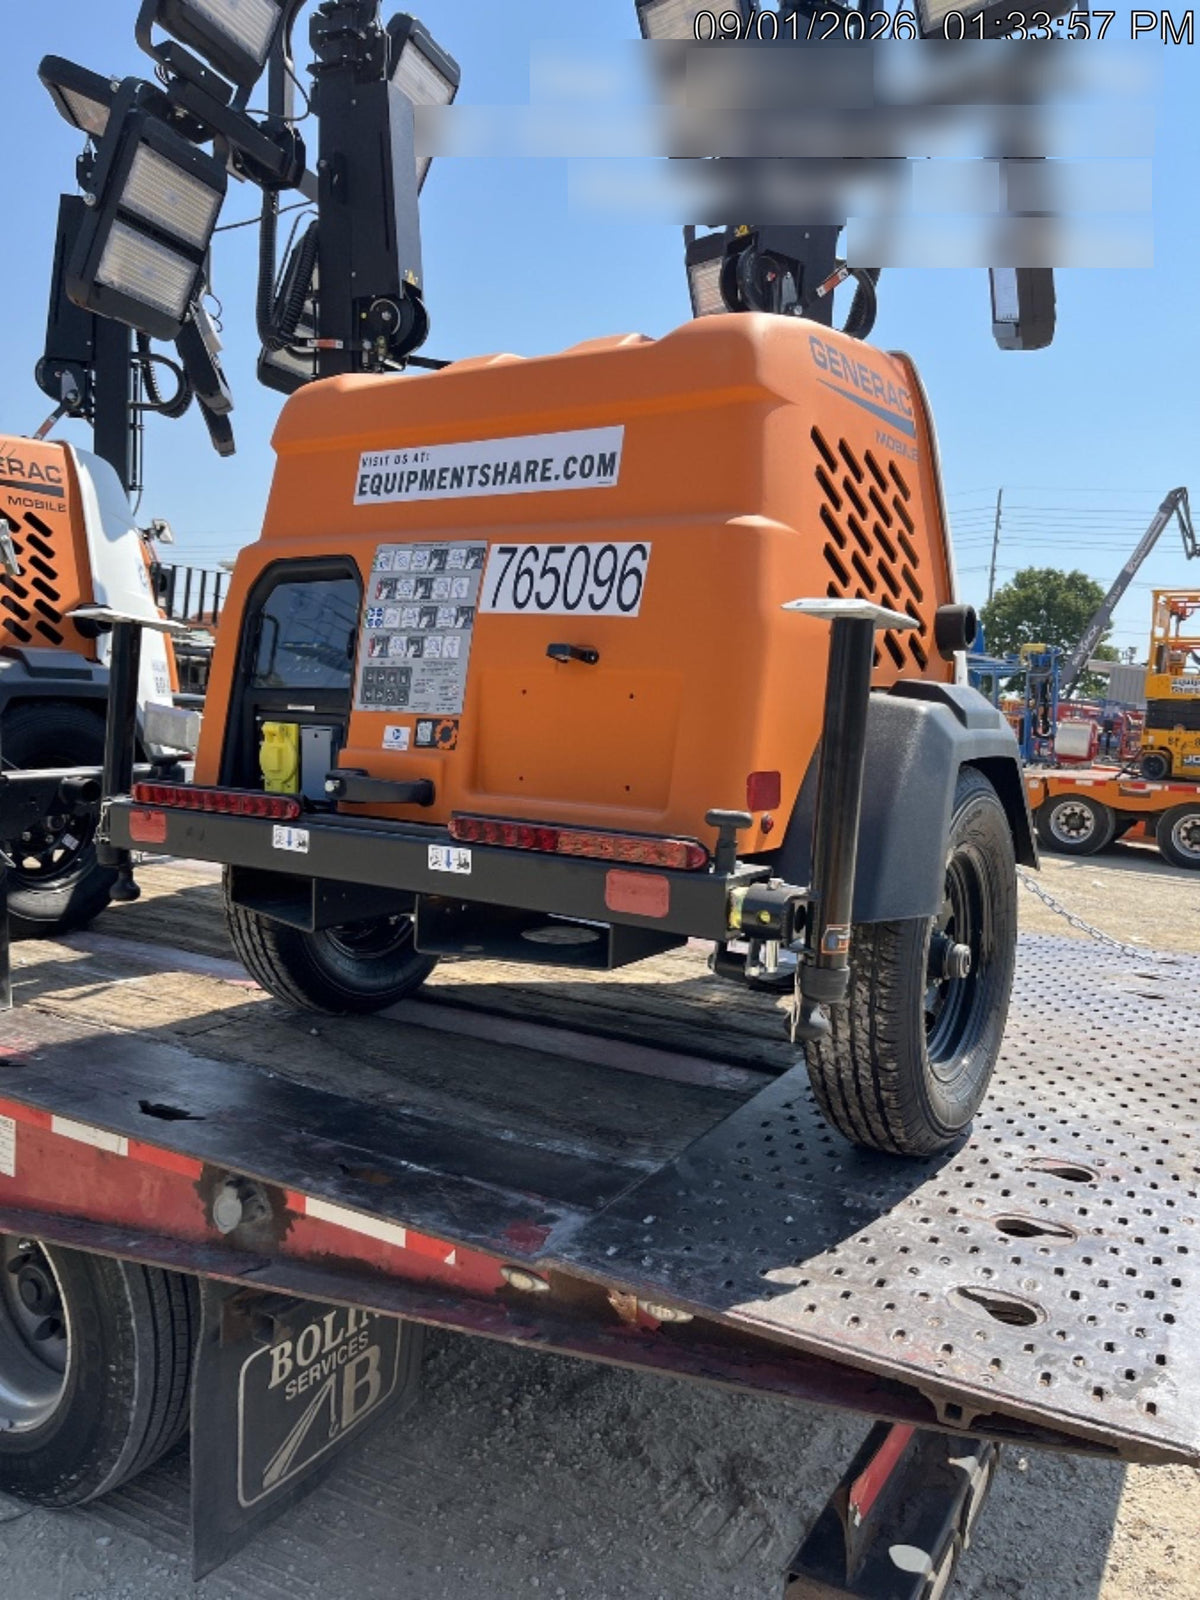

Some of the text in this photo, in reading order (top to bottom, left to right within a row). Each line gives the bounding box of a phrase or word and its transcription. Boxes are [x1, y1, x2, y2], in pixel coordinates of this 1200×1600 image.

[809, 335, 913, 416] GENERAC
[358, 451, 618, 498] EQUIPMENTSHARE.COM
[361, 451, 430, 468] VISIT US AT:
[875, 430, 920, 461] MOBILE
[7, 495, 67, 513] MOBILE
[491, 543, 648, 612] 765096
[268, 1307, 380, 1389] BOLI
[285, 1331, 369, 1401] SERVICES
[342, 1345, 382, 1429] B
